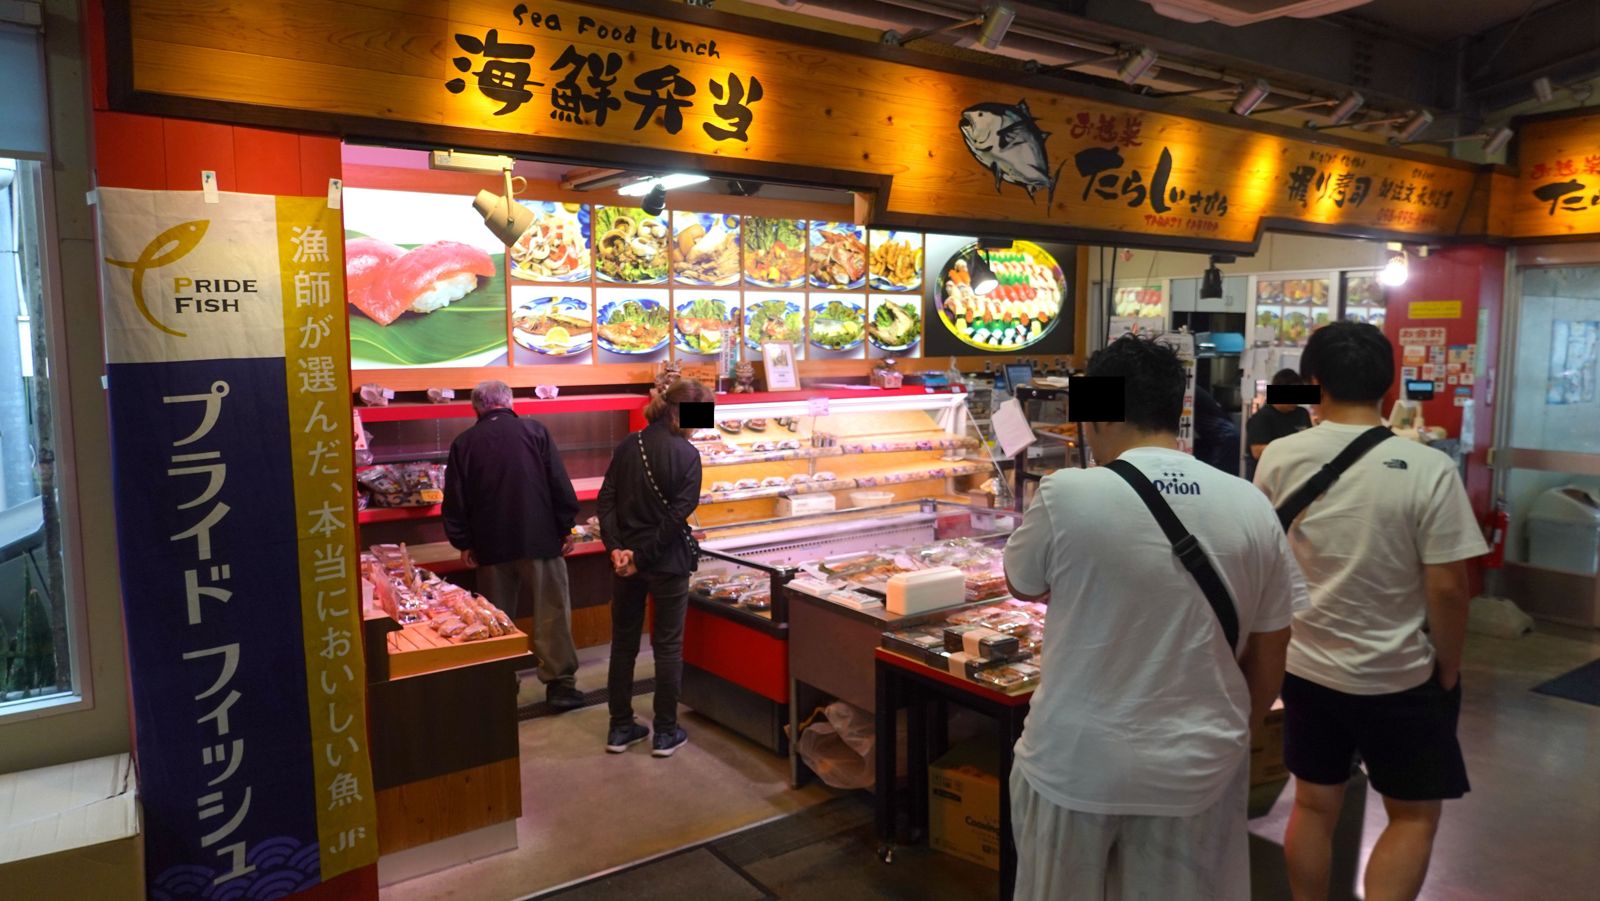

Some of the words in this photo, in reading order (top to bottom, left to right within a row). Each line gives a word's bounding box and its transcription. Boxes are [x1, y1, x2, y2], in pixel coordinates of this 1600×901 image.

[513, 4, 562, 31] Sea
[578, 16, 637, 44] Food
[444, 28, 764, 142] 海鮮弁当
[1288, 165, 1371, 208] 握り寿司
[174, 277, 258, 294] PRIDE
[175, 297, 240, 313] FISH
[163, 380, 234, 625] プライド
[290, 225, 363, 812] 漁師が選んだ、本当においしい魚
[182, 643, 257, 886] フィッシュ
